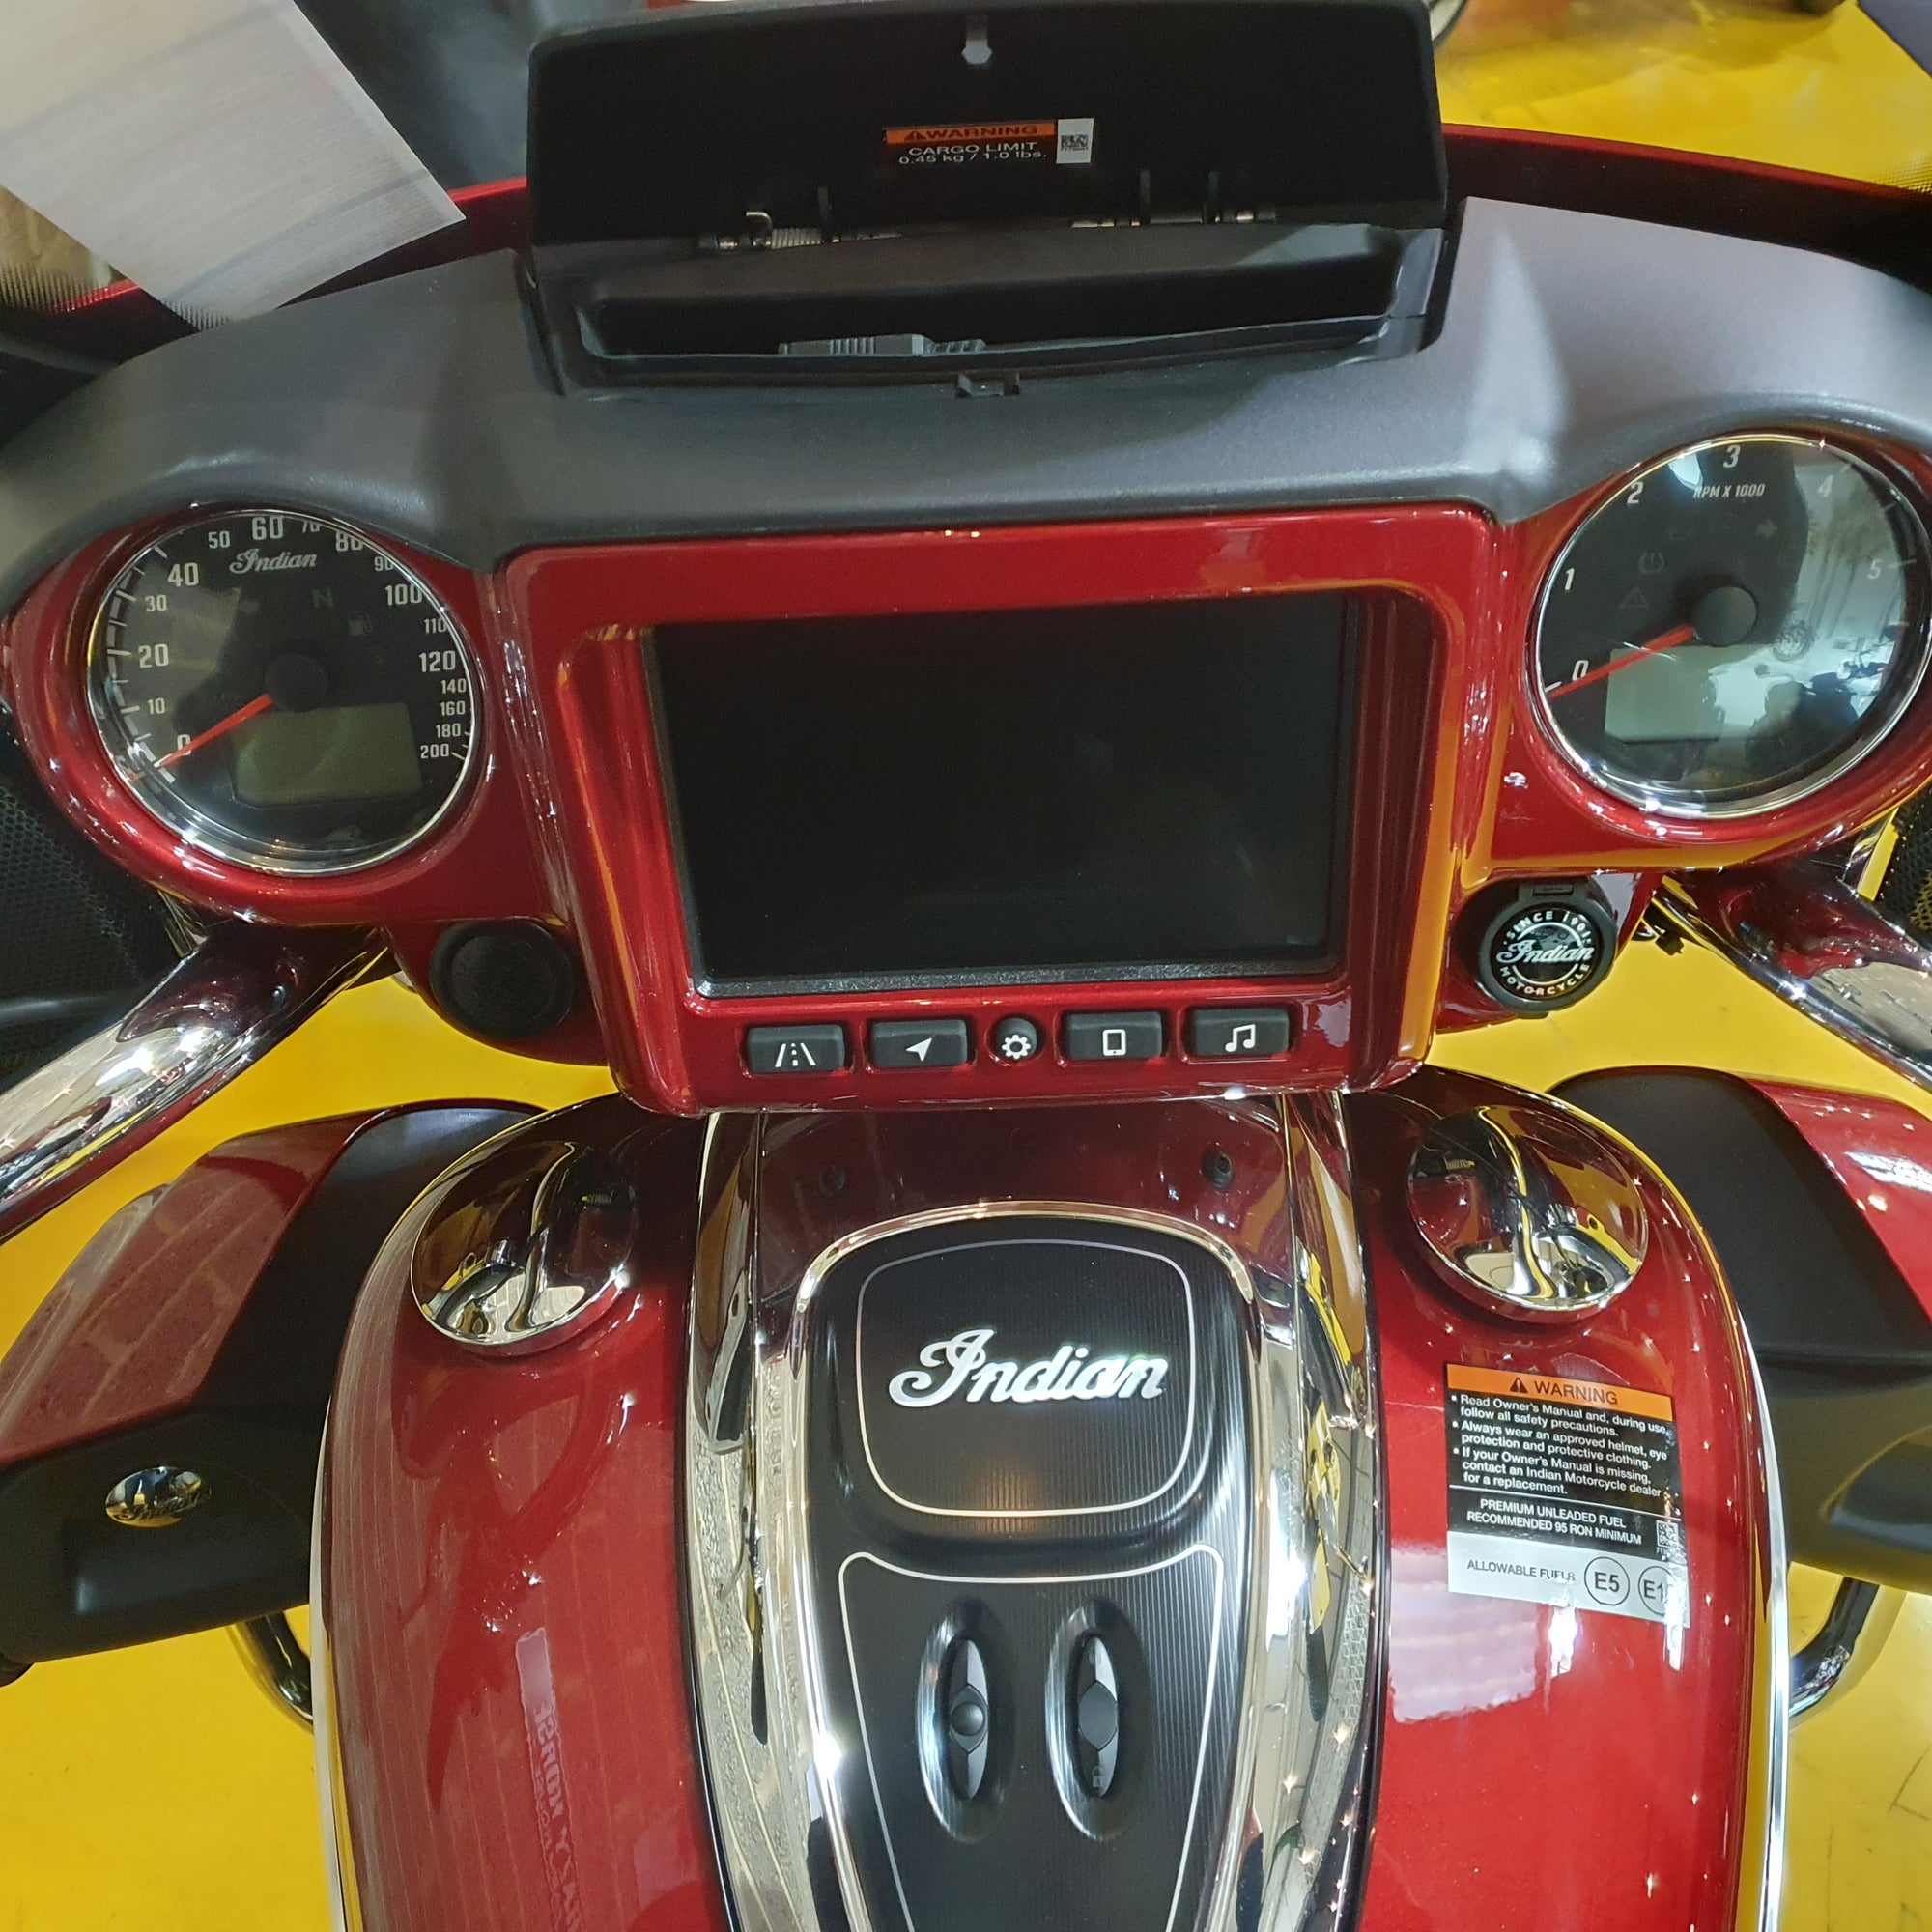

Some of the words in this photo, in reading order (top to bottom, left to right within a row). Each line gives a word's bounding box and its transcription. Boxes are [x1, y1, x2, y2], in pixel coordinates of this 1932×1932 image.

[925, 126, 1038, 140] WARNING
[898, 155, 937, 165] 0.45
[942, 154, 964, 163] kg
[982, 151, 1010, 159] 1.0
[908, 144, 980, 156] CARGO
[986, 141, 1037, 152] LIMIT
[1722, 445, 1741, 469] 3
[1627, 481, 1644, 504] 2
[1692, 484, 1721, 499] RPM
[1722, 484, 1732, 498] X
[1734, 483, 1766, 497] 1000
[1817, 474, 1834, 497] 4
[208, 530, 231, 549] 50
[251, 516, 284, 540] 60
[335, 530, 365, 552] 80
[229, 549, 318, 575] Indian
[374, 556, 394, 572] 90
[1867, 559, 1883, 580] 5
[167, 562, 199, 586] 40
[1564, 568, 1576, 591] 1
[145, 594, 168, 611] 30
[384, 583, 423, 606] 100
[423, 617, 447, 634] 110
[138, 644, 169, 668] 20
[419, 651, 457, 673] 120
[1572, 660, 1589, 679] 0
[441, 678, 467, 694] 140
[147, 697, 165, 715] 10
[440, 701, 466, 716] 160
[436, 724, 462, 739] 180
[177, 734, 192, 756] 0
[420, 743, 450, 759] 200
[1506, 910, 1554, 940] SINCE
[1495, 939, 1596, 964] Indian
[1499, 962, 1590, 996] MOTORCYCLE
[889, 1328, 1169, 1407] Indian
[1534, 1379, 1618, 1406] WARNING
[1460, 1394, 1491, 1406] Read
[1493, 1398, 1540, 1413] Owner's
[1542, 1404, 1583, 1419] Manual
[1612, 1415, 1646, 1433] during
[1460, 1406, 1494, 1420] follow
[1497, 1411, 1511, 1422] all
[1514, 1413, 1548, 1429] safety
[1550, 1419, 1619, 1436] precautions.
[1461, 1420, 1502, 1435] Always
[1505, 1427, 1533, 1438] wear
[1536, 1433, 1550, 1441] an
[1552, 1433, 1605, 1449] approved
[1608, 1439, 1647, 1457] helmet,
[1649, 1448, 1668, 1462] eye
[1461, 1434, 1520, 1449] protection
[1522, 1441, 1546, 1452] and
[1548, 1444, 1604, 1461] protective
[1605, 1452, 1652, 1470] clothing.
[1462, 1446, 1471, 1458] If
[1472, 1450, 1499, 1462] your
[1501, 1451, 1548, 1466] Owner's
[1550, 1457, 1592, 1473] Manual
[1595, 1463, 1605, 1475] is
[1607, 1467, 1652, 1485] missing,
[1462, 1461, 1507, 1474] contact
[1509, 1467, 1524, 1477] an
[1526, 1466, 1562, 1481] Indian
[1565, 1471, 1627, 1491] Motorcycle
[1629, 1483, 1662, 1498] dealer
[1463, 1471, 1481, 1483] for
[1483, 1475, 1491, 1485] a
[1492, 1477, 1568, 1494] replacement.
[1480, 1498, 1535, 1516] PREMIUM
[1537, 1502, 1597, 1523] UNLEADED
[1599, 1516, 1627, 1528] FUEL
[1466, 1511, 1553, 1531] RECOMMENDED
[1554, 1521, 1568, 1534] 95
[1569, 1523, 1593, 1537] RON
[1594, 1528, 1642, 1545] MINIMUM
[1466, 1559, 1538, 1577] ALLOWABLE
[1594, 1571, 1621, 1593] E5
[1643, 1578, 1667, 1603] E1
